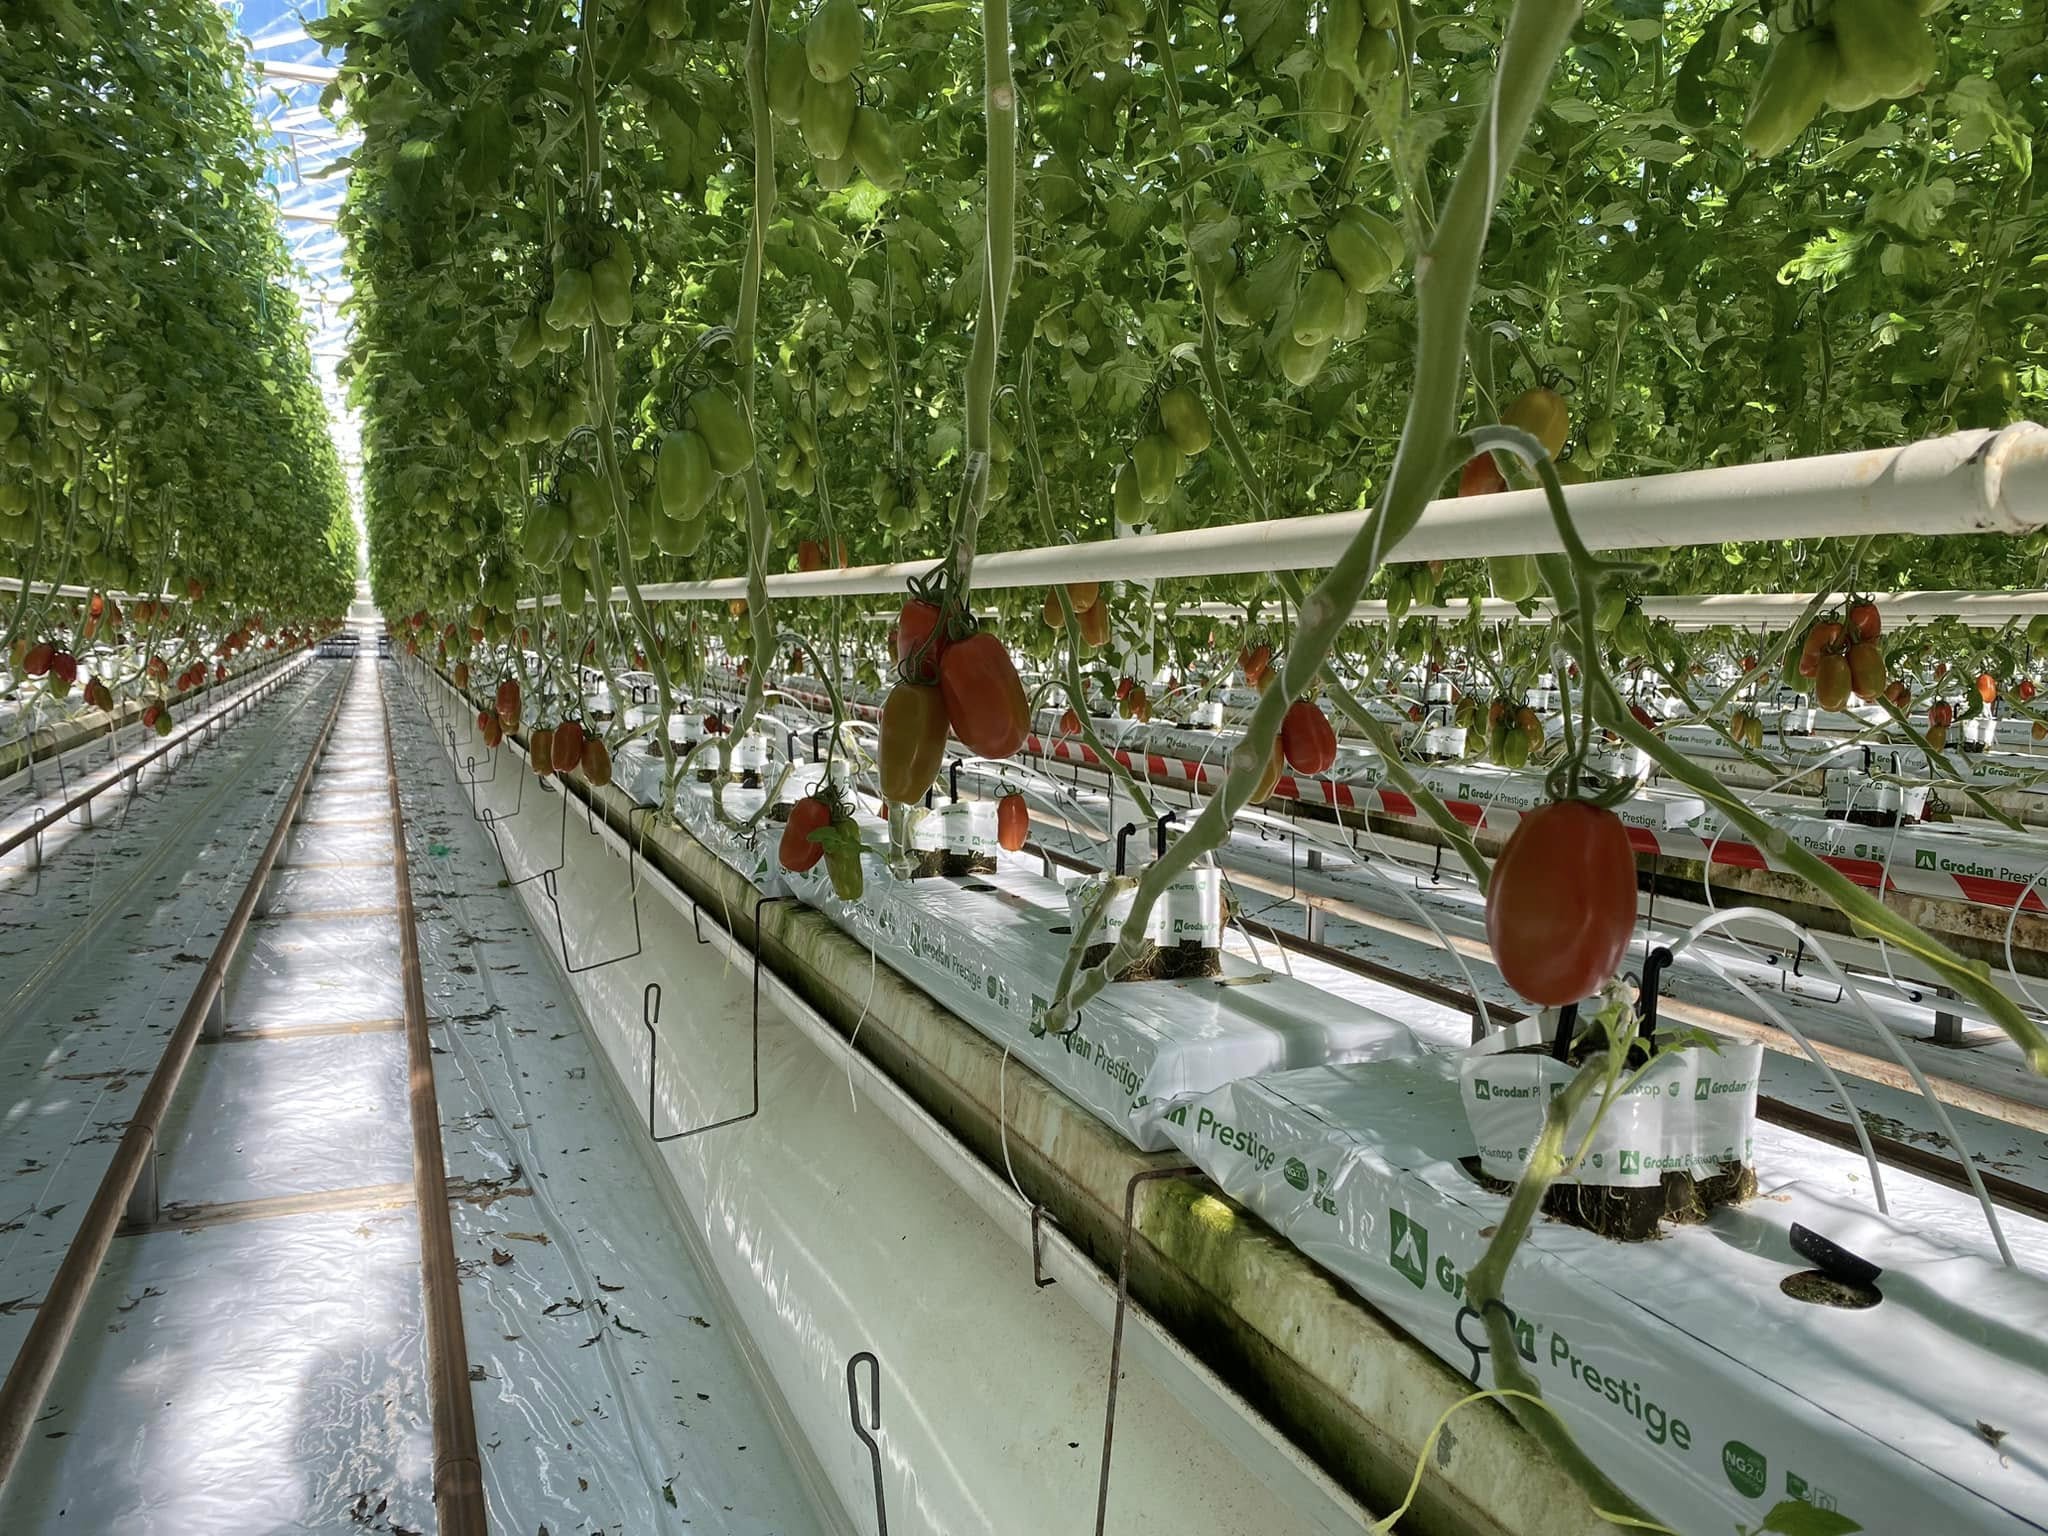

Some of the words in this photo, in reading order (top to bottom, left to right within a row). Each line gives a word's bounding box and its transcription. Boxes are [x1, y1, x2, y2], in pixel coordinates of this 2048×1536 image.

[1622, 811, 1657, 829] Prestige
[1804, 836, 1847, 856] Prestige
[1940, 858, 1994, 878] Grodan
[1492, 1086, 1529, 1098] Grodan
[1712, 1080, 1747, 1094] Grodan
[1197, 1107, 1276, 1172] Prestige
[1550, 1331, 1691, 1451] Prestige
[1726, 1449, 1765, 1483] NG2.0
